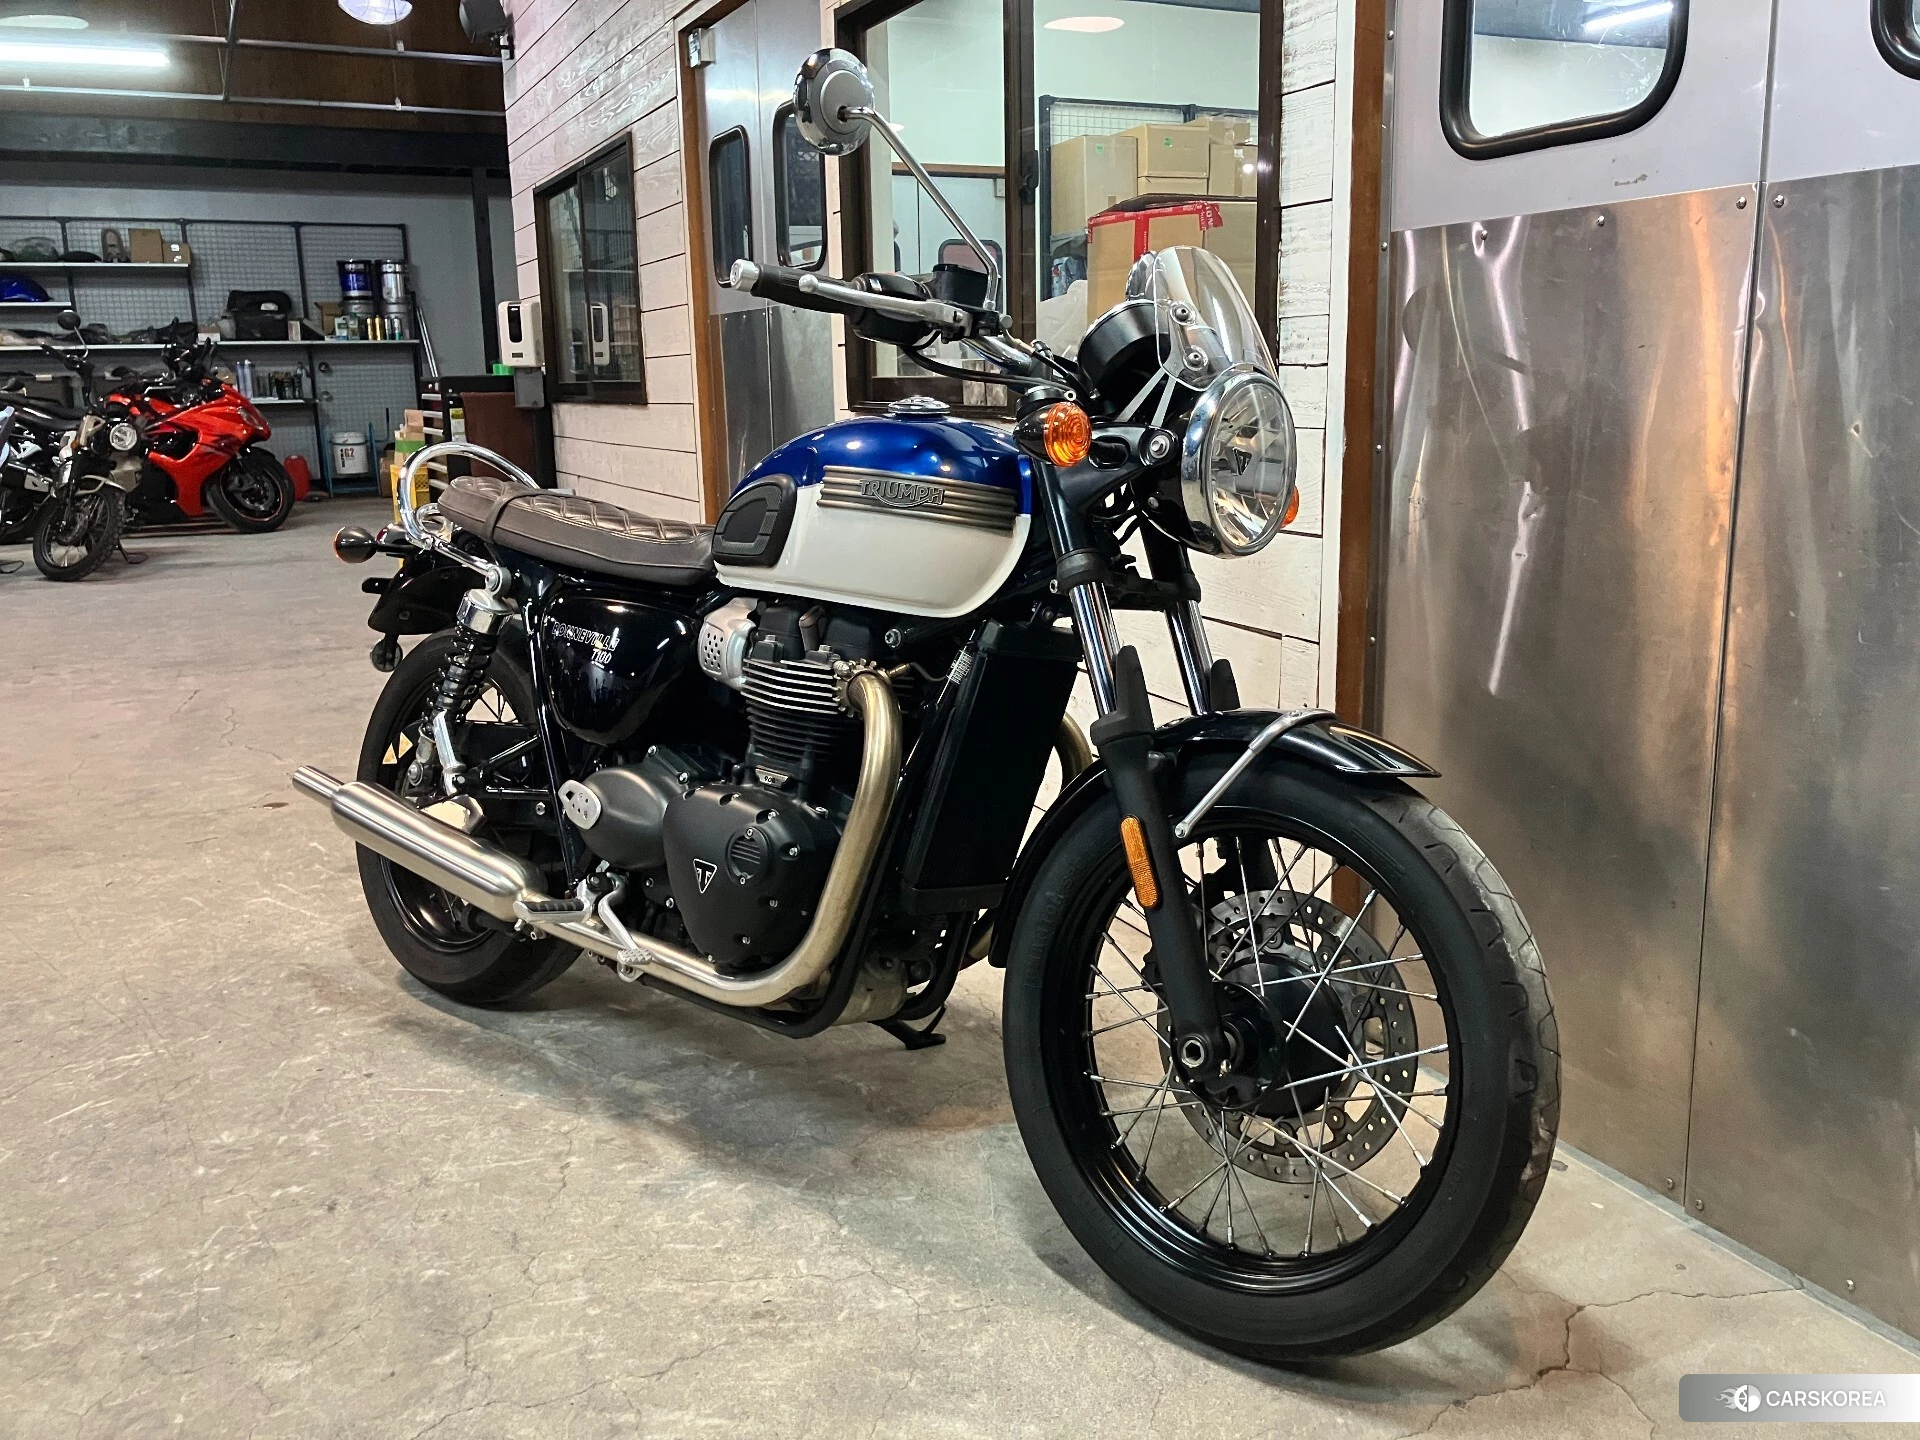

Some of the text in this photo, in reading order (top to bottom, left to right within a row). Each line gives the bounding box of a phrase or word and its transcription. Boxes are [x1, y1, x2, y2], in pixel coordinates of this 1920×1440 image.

[860, 480, 945, 507] TRIUMPH
[552, 621, 620, 651] BONNEVILLE
[591, 648, 612, 664] T100
